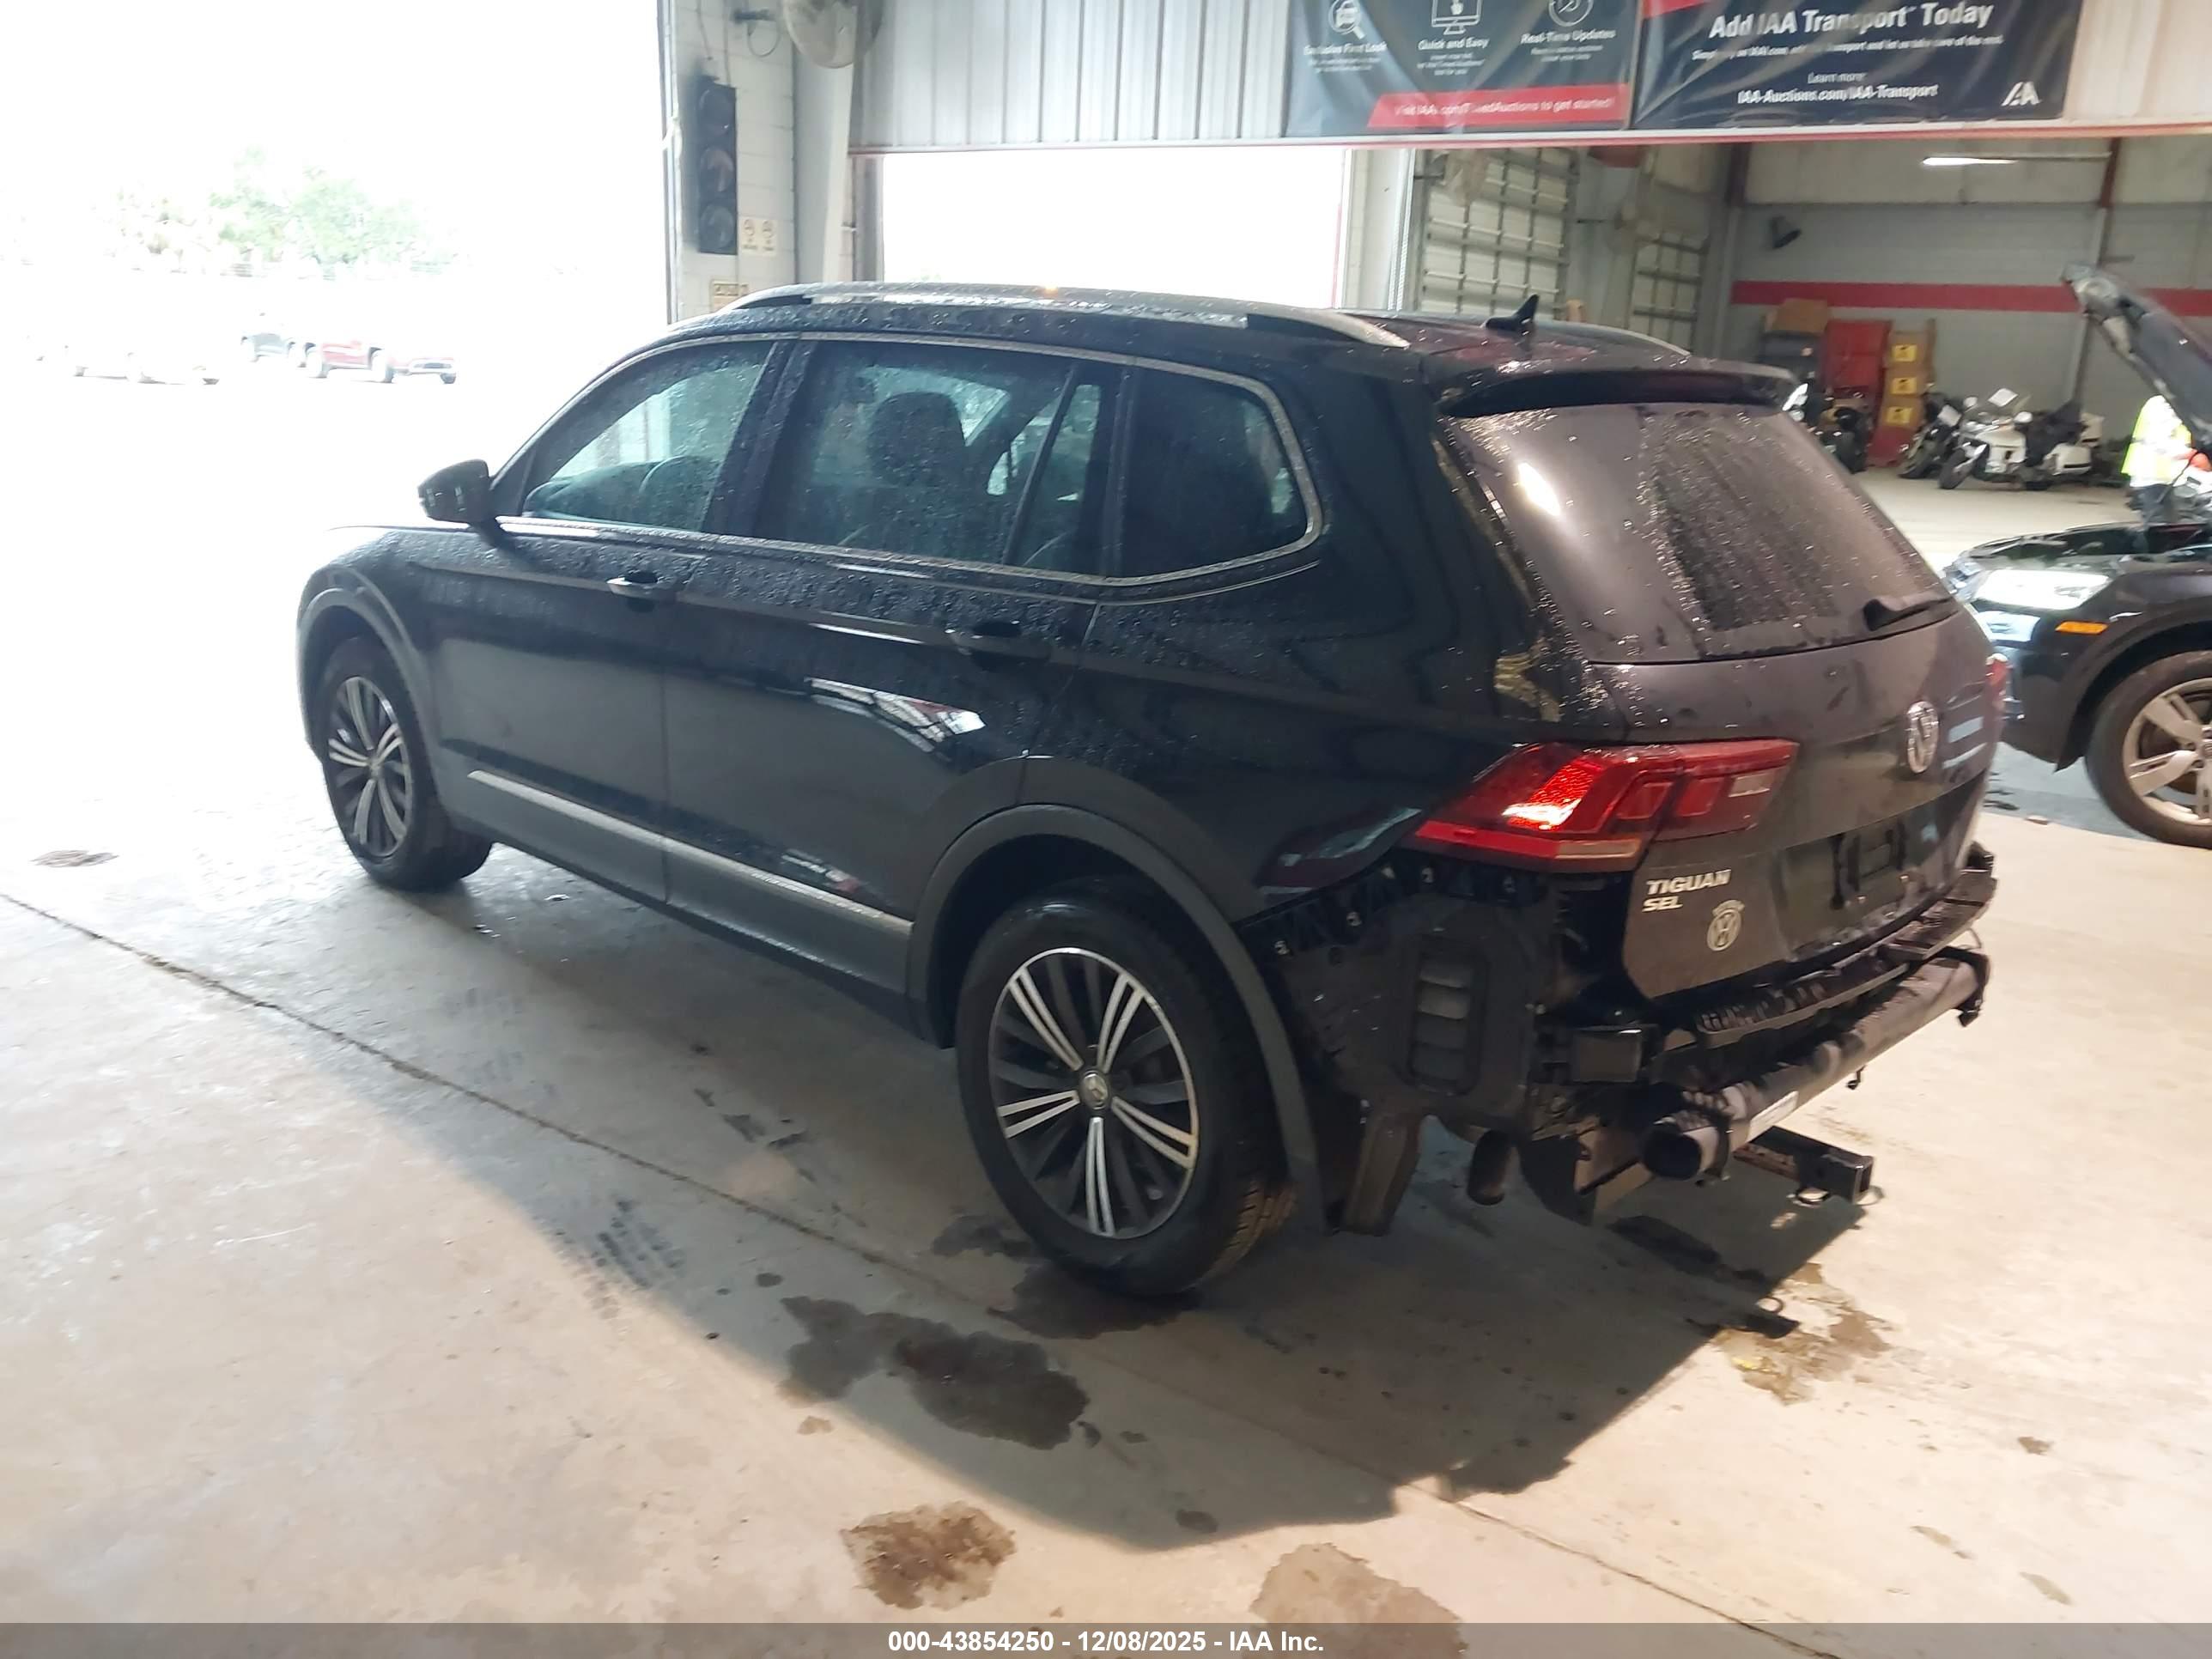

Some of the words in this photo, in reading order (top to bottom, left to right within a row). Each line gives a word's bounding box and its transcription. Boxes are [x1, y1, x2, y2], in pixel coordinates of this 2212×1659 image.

[1709, 16, 1753, 39] Add
[1757, 11, 1796, 34] IAA
[1802, 7, 1908, 34] Transport
[1920, 3, 1995, 28] Today
[1645, 868, 1732, 896] TIGUAN
[1641, 895, 1684, 913] SEL
